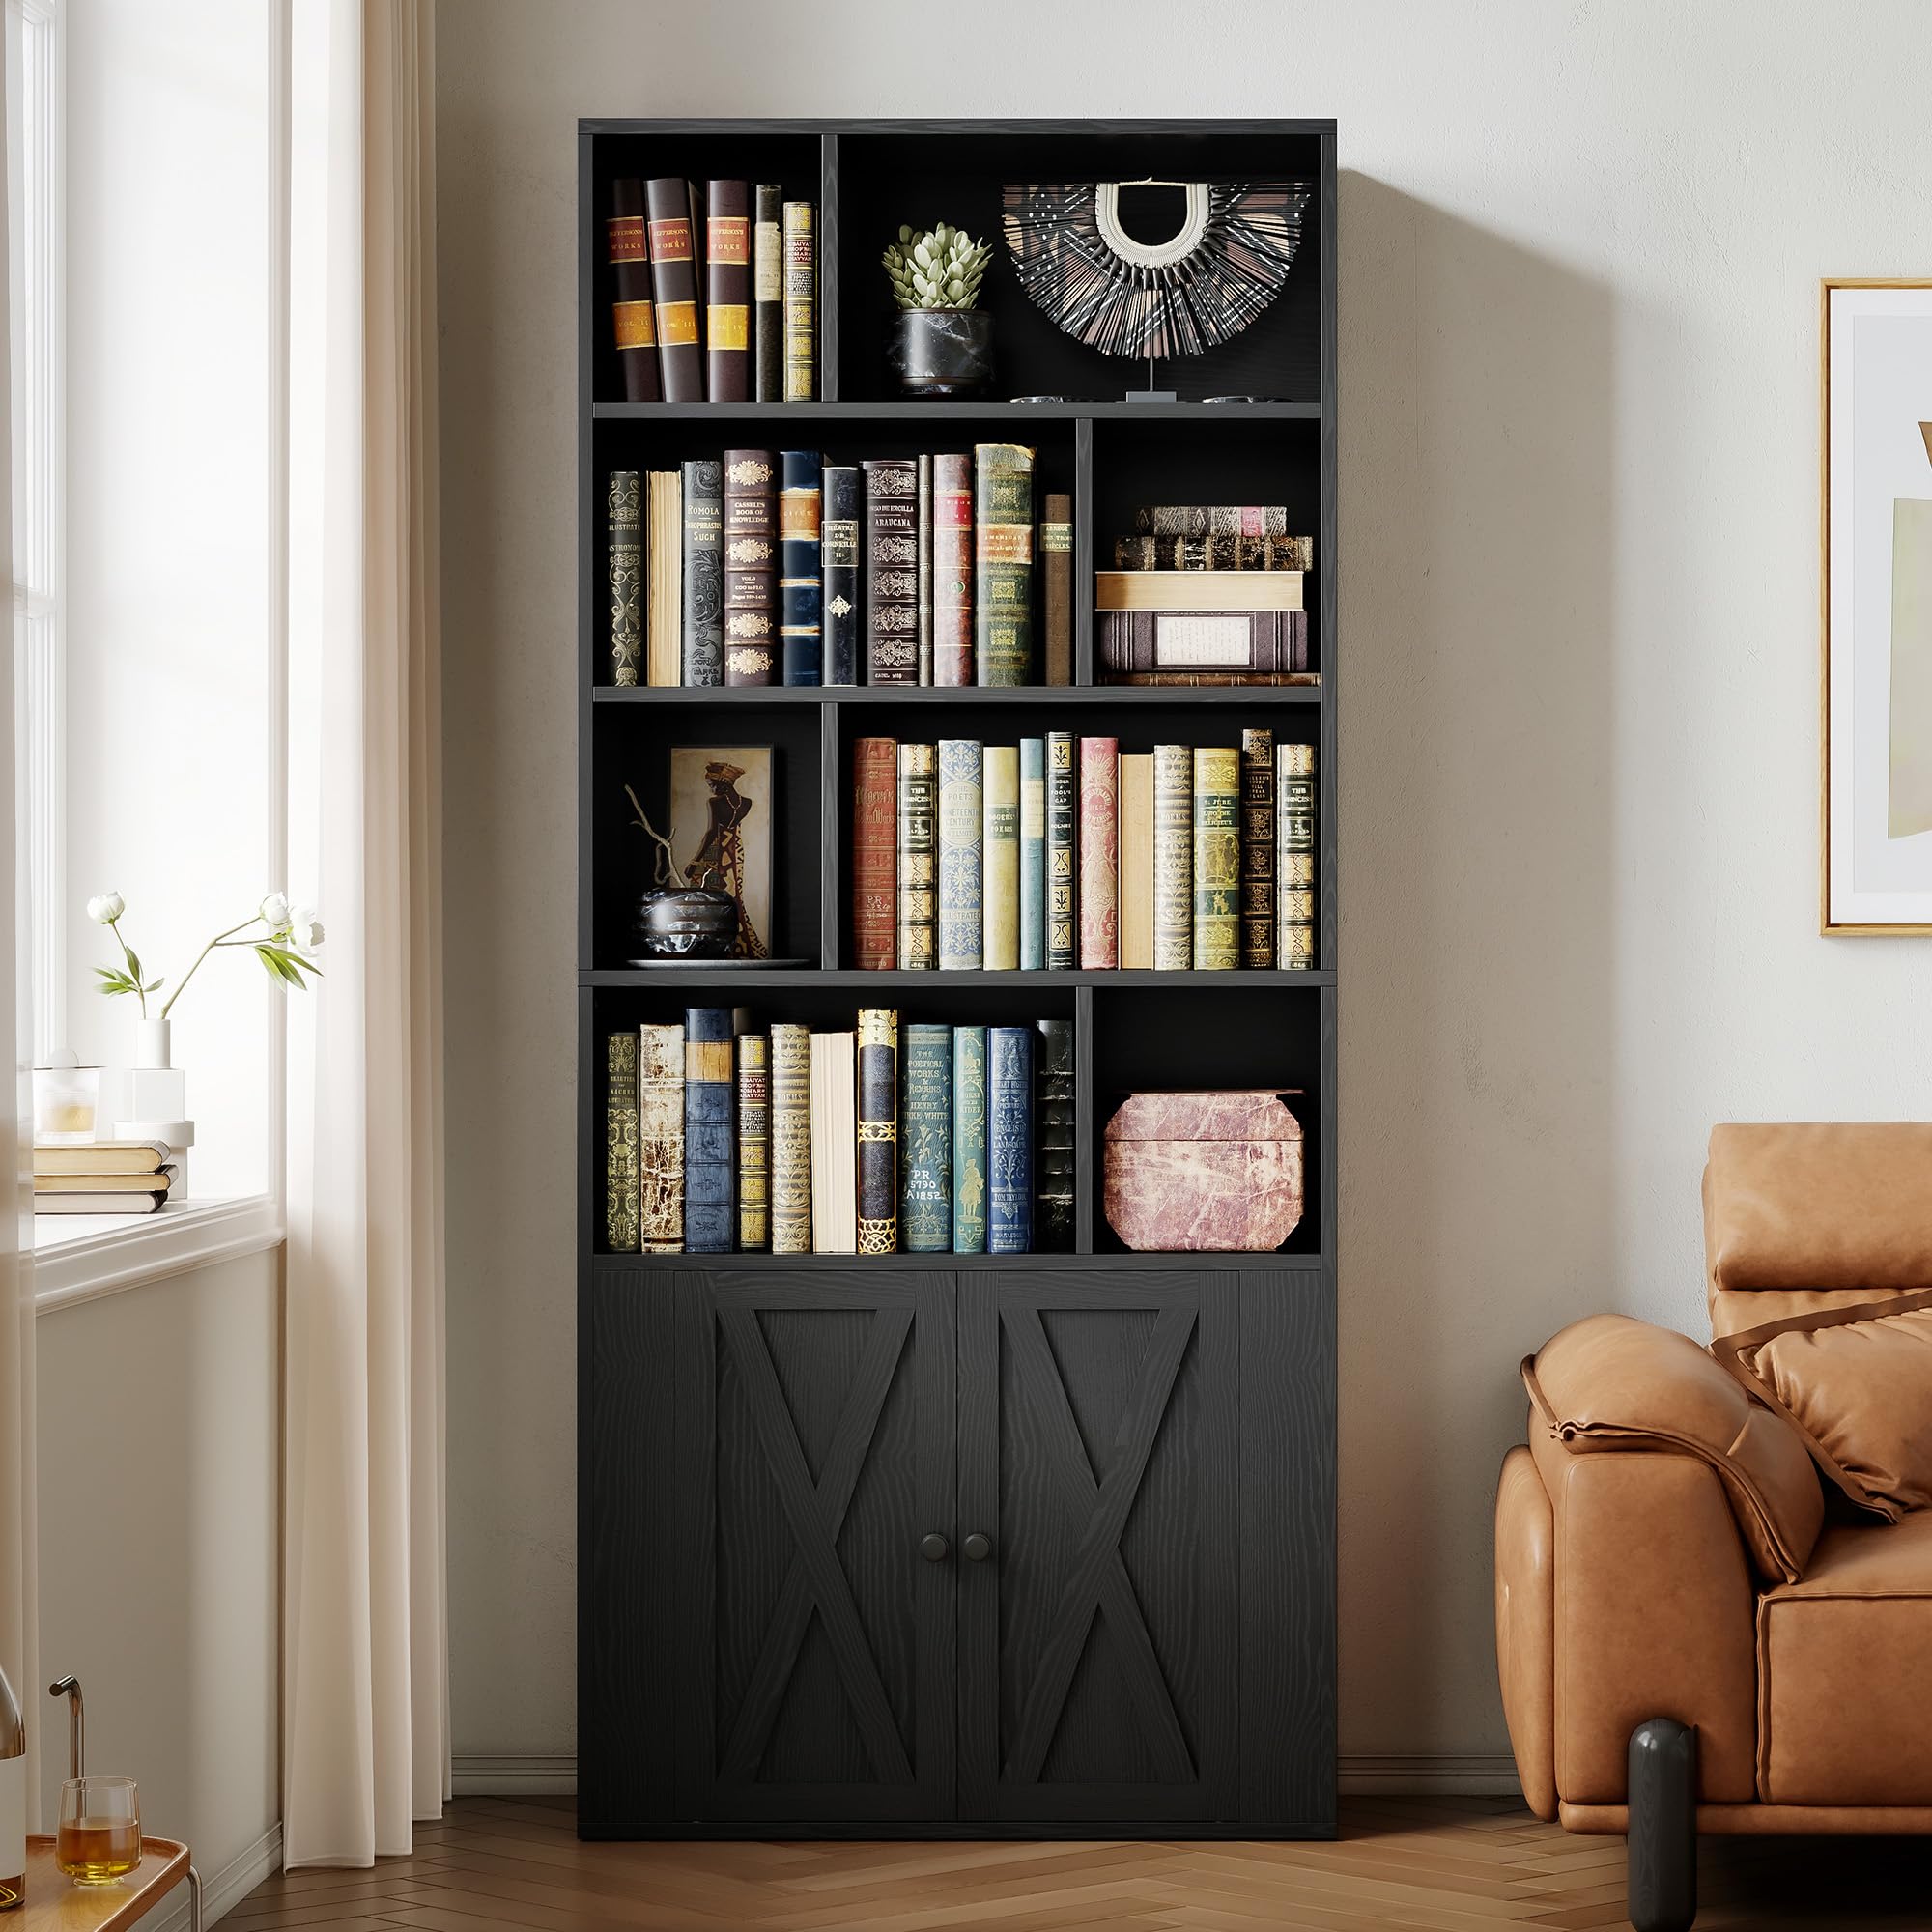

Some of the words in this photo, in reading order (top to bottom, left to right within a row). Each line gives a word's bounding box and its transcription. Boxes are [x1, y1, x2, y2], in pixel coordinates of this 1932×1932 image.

[655, 242, 685, 250] WORKS
[687, 504, 720, 516] ROMOLA
[874, 518, 911, 527] ARAUCANA
[693, 531, 715, 541] SUCH
[866, 895, 882, 905] PR
[907, 1060, 943, 1068] POETICAL
[908, 1069, 940, 1078] WORKS
[911, 1101, 938, 1110] HENRY
[911, 1169, 930, 1180] PR
[910, 1180, 936, 1189] 5790
[906, 1189, 943, 1200] A1852
